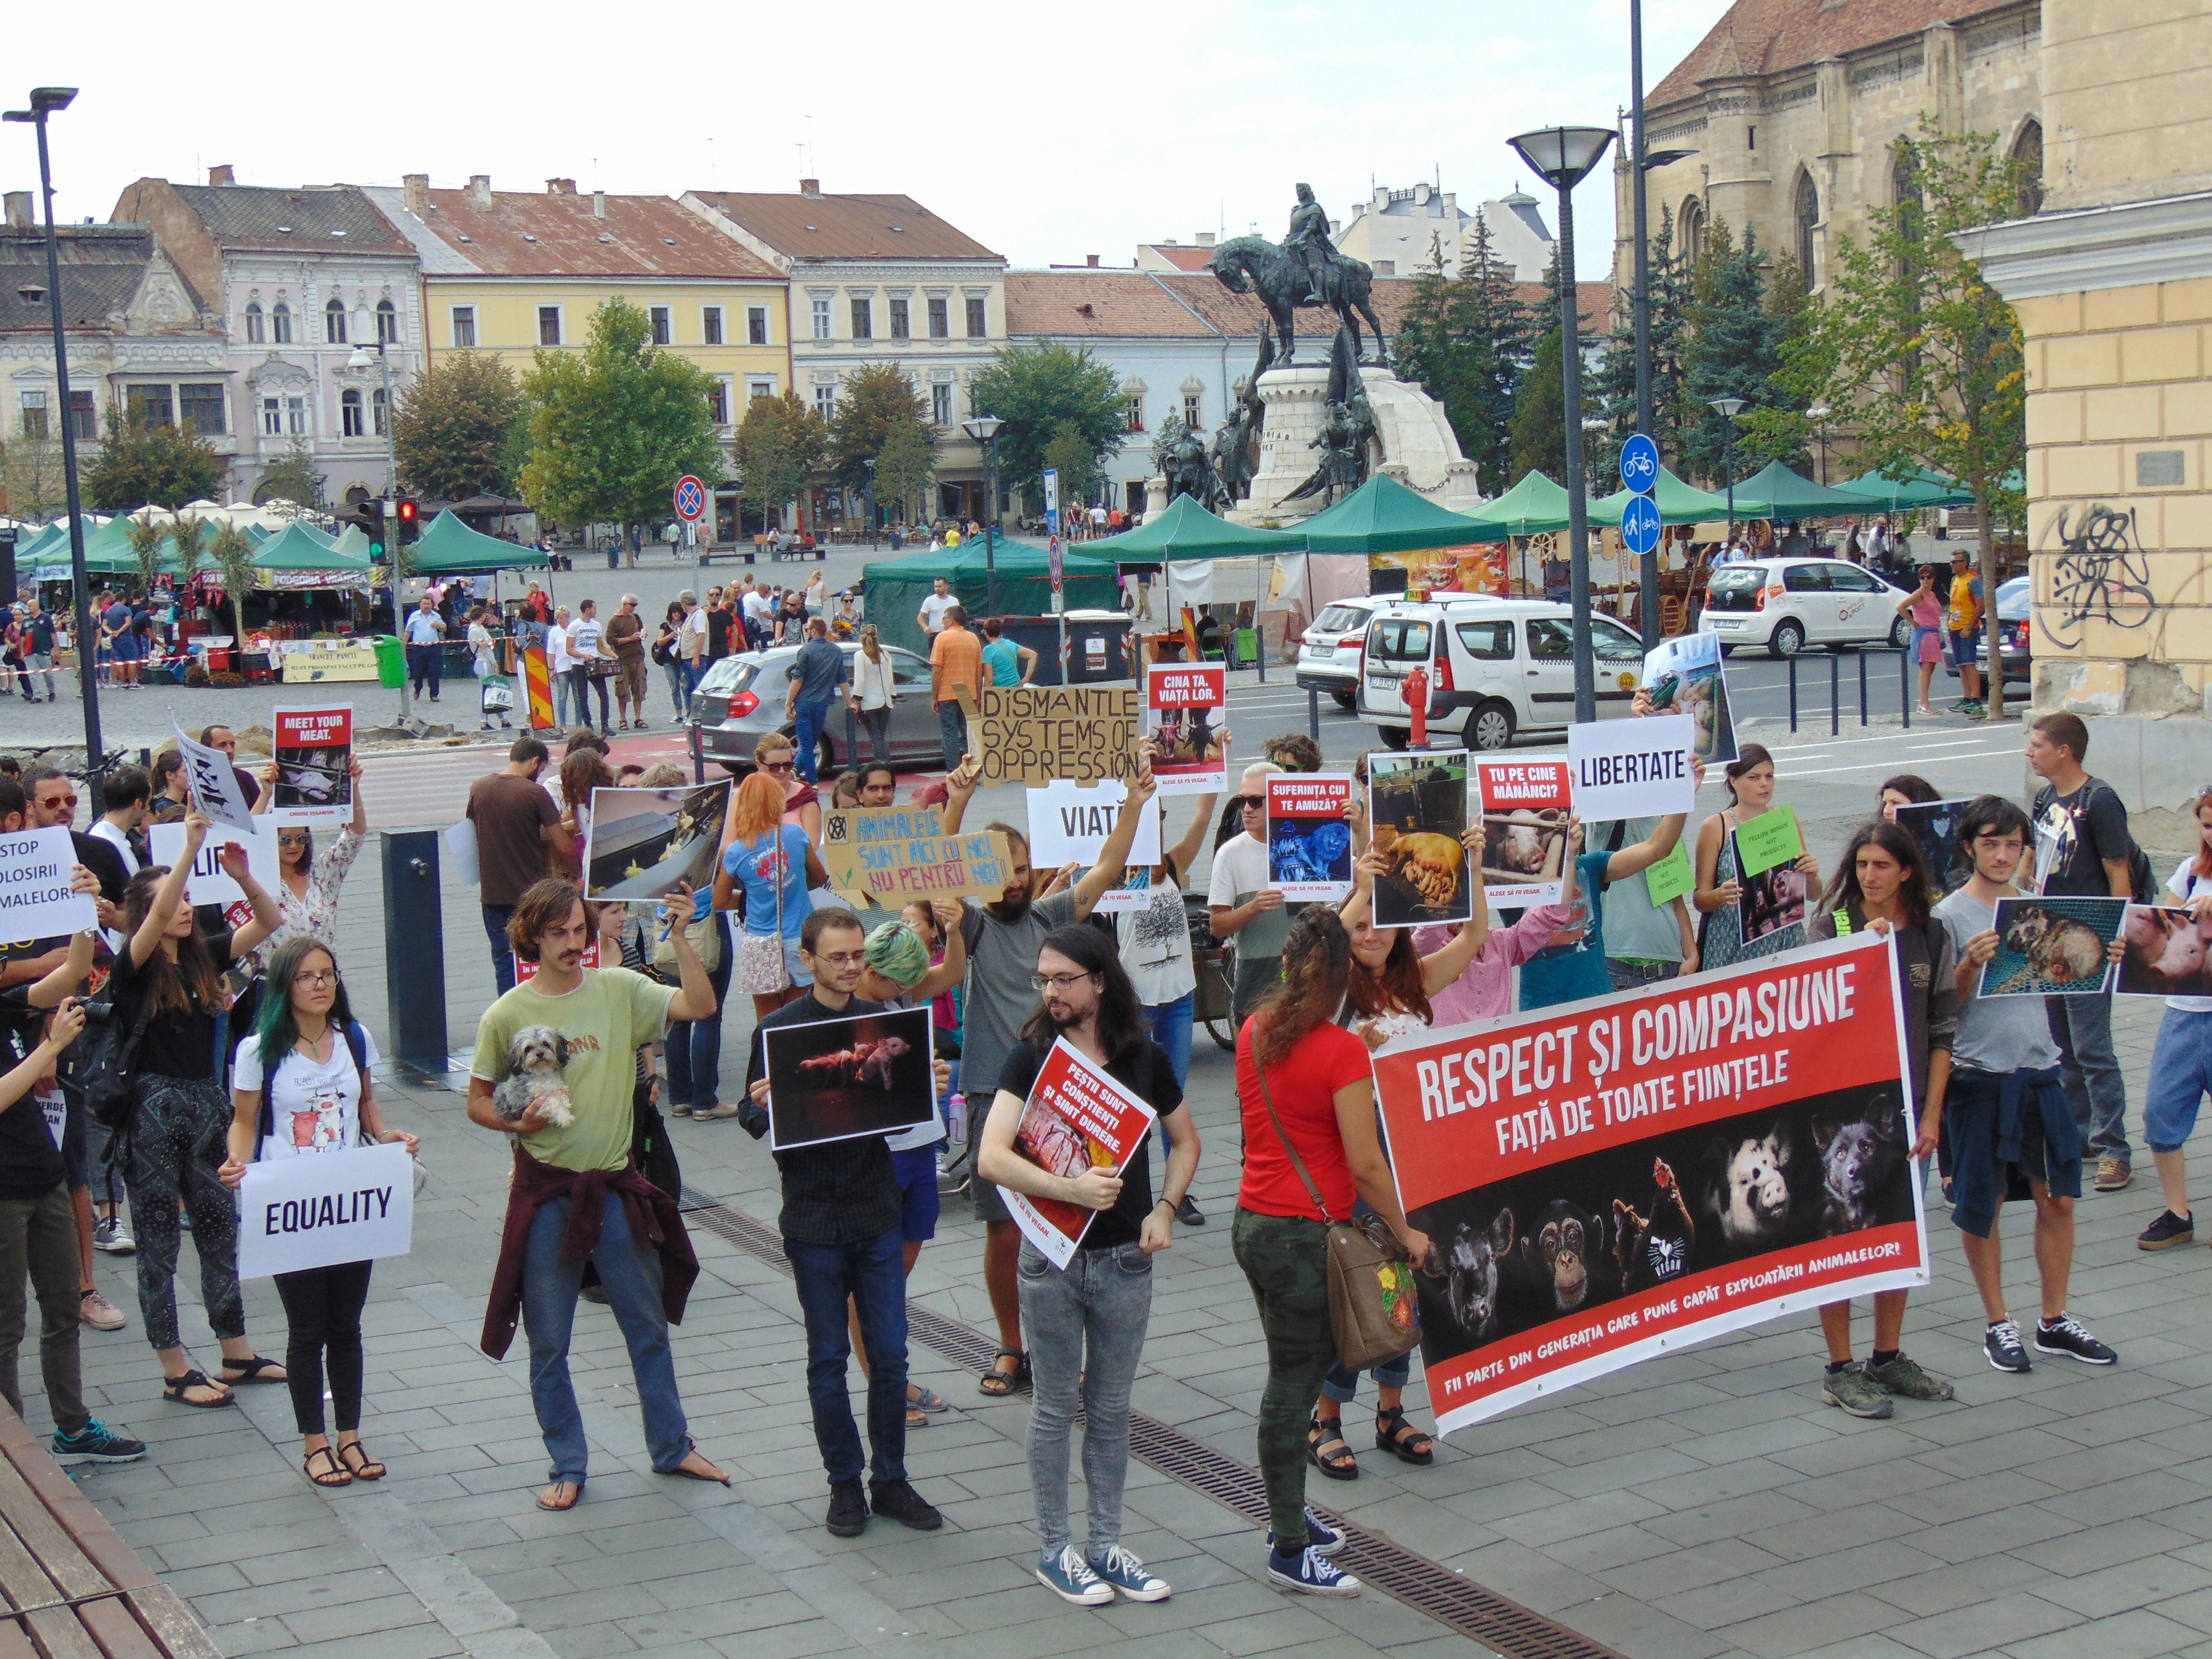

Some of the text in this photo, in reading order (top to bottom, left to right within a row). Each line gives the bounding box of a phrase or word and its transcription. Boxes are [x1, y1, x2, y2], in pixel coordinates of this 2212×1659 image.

[274, 574, 367, 584] PODGORIA VRANCEA
[1409, 590, 1422, 598] TAXI
[1164, 675, 1209, 688] CINA TA.
[1159, 688, 1216, 706] VIAȚA LOR.
[285, 715, 343, 729] MEET YOUR
[300, 729, 331, 741] MEAT.
[981, 719, 1139, 751] SYSTEMS OF
[1489, 767, 1557, 782] TU PE CINE
[1580, 749, 1686, 788] LIBERTATE
[1273, 785, 1345, 799] SUFERINȚA CUI
[1493, 782, 1558, 799] MĂNÂNCI?
[1281, 798, 1337, 811] TE AMUZĂ?
[0, 840, 39, 857] STOP
[859, 843, 902, 870] SUNT
[942, 840, 960, 860] CU
[1759, 843, 1787, 858] PRODUCTS
[194, 846, 225, 877] LIF
[869, 871, 894, 893] NU
[899, 862, 965, 891] PENTRU
[1658, 877, 1679, 891] PRODUCTS
[1417, 963, 1855, 1122] RESPECT ȘI COMPASIUNE
[1067, 1062, 1128, 1115] PEȘTII SUNT
[39, 1102, 64, 1112] ERDE
[1062, 1080, 1120, 1130] CONȘTIENȚI
[1495, 1049, 1789, 1155] FAȚĂ DE TOATE FIINȚELE
[1043, 1085, 1121, 1154] ȘI SIMT DURERE.
[265, 1185, 392, 1236] EQUALITY
[1031, 1216, 1050, 1238] VEGAN.
[1655, 1259, 1681, 1276] VEGAN
[1444, 1242, 1900, 1396] FII PARTE DIN GENERAȚIA CARE PUNE CAPĂT EXPLOATĂRII ANIMALELOR!
